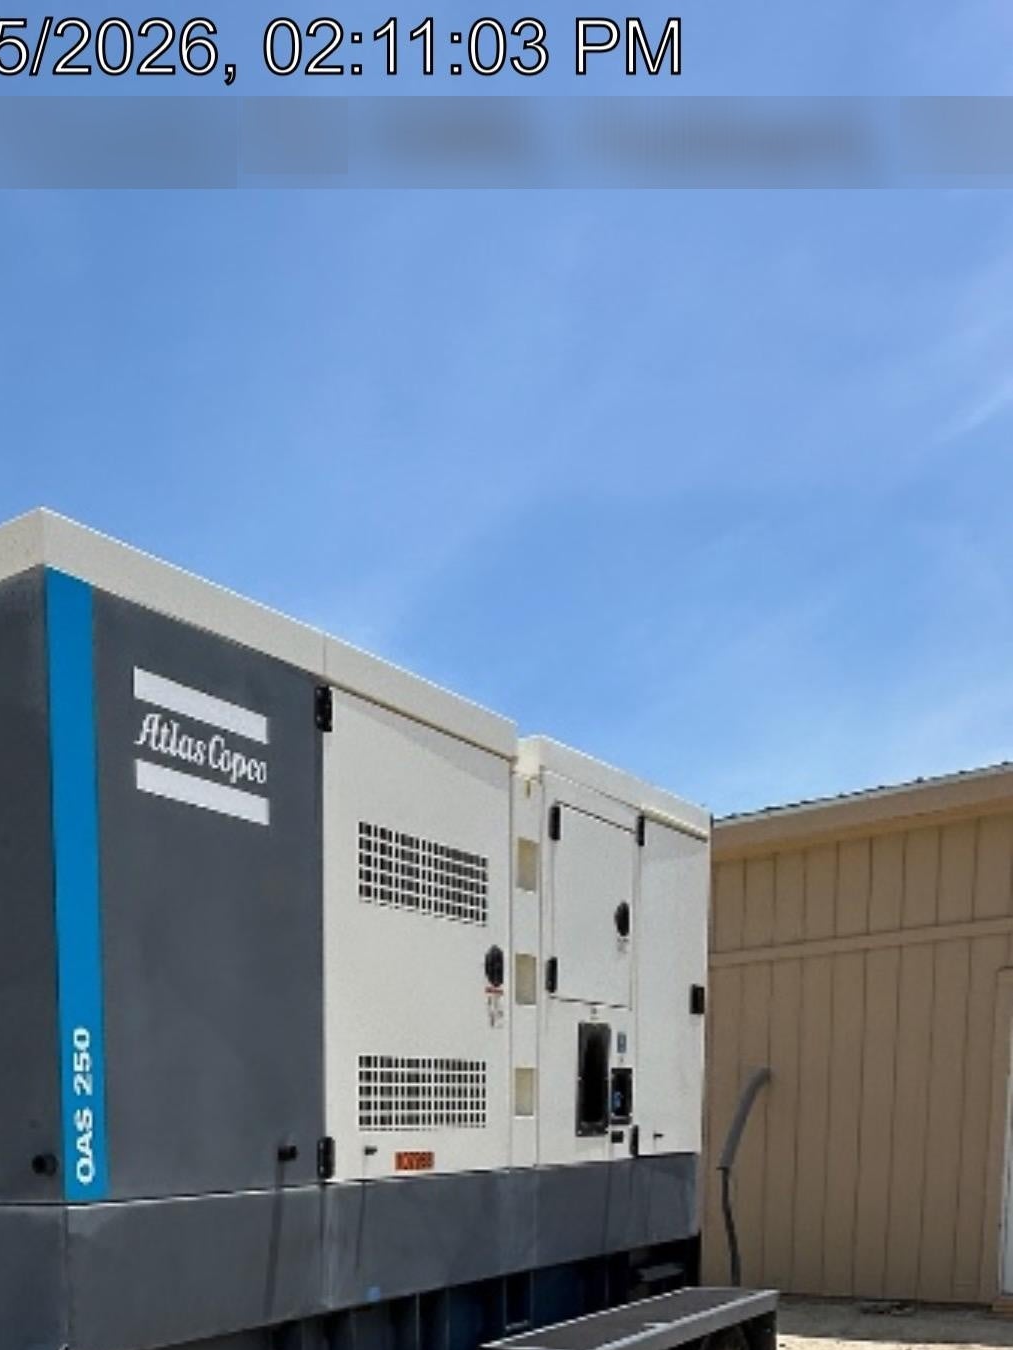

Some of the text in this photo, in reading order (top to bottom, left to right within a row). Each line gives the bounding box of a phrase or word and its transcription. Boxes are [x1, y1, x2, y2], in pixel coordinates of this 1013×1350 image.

[134, 713, 267, 784] Atlas Copco
[73, 1027, 95, 1185] QAS 250
